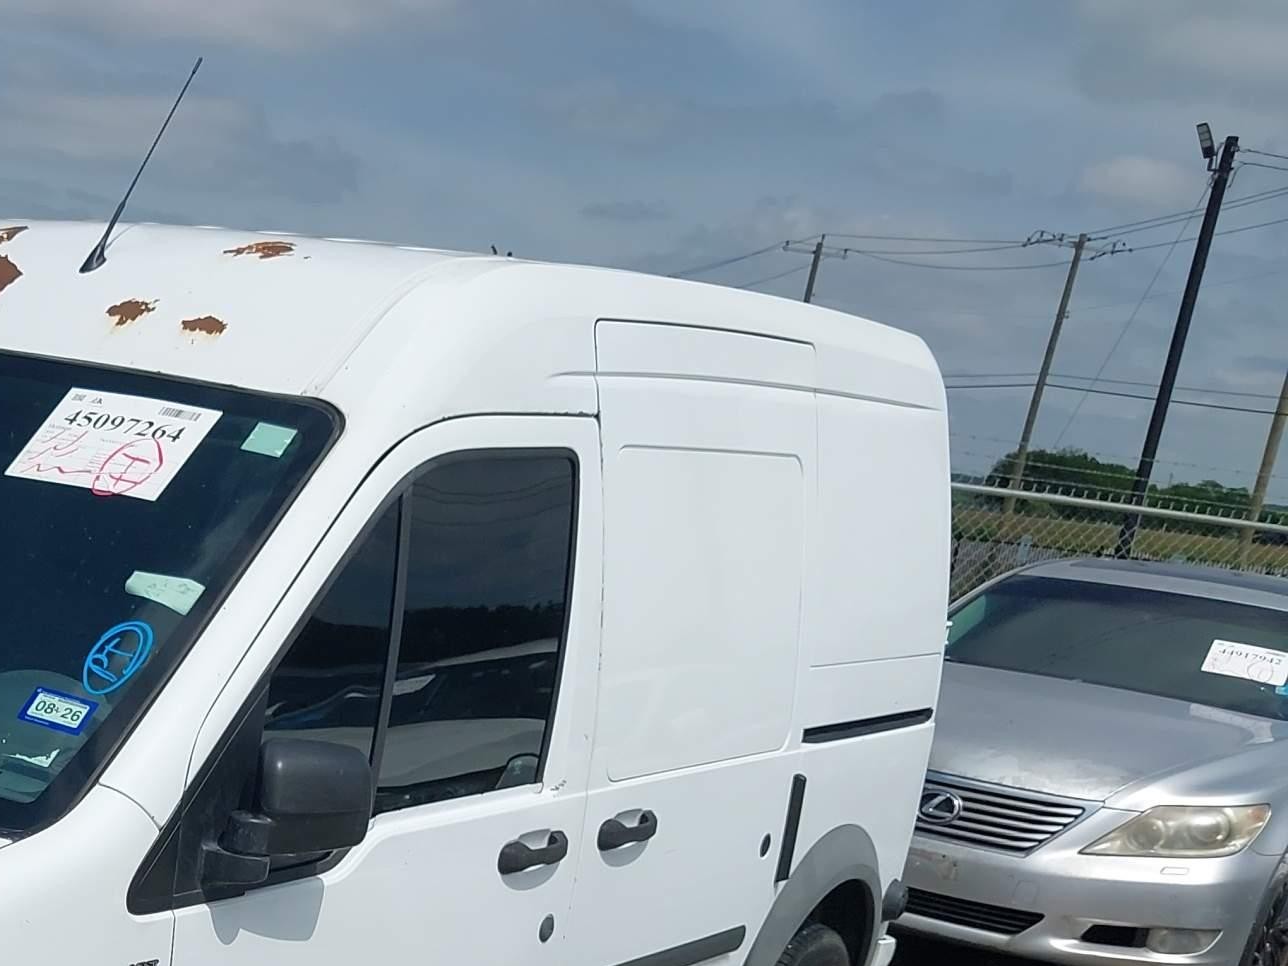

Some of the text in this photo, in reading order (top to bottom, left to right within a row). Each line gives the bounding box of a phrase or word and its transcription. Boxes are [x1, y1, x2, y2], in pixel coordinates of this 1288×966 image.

[64, 409, 186, 443] 45097264
[1218, 648, 1282, 665] 44917942
[35, 700, 56, 714] 08
[60, 707, 83, 722] 26
